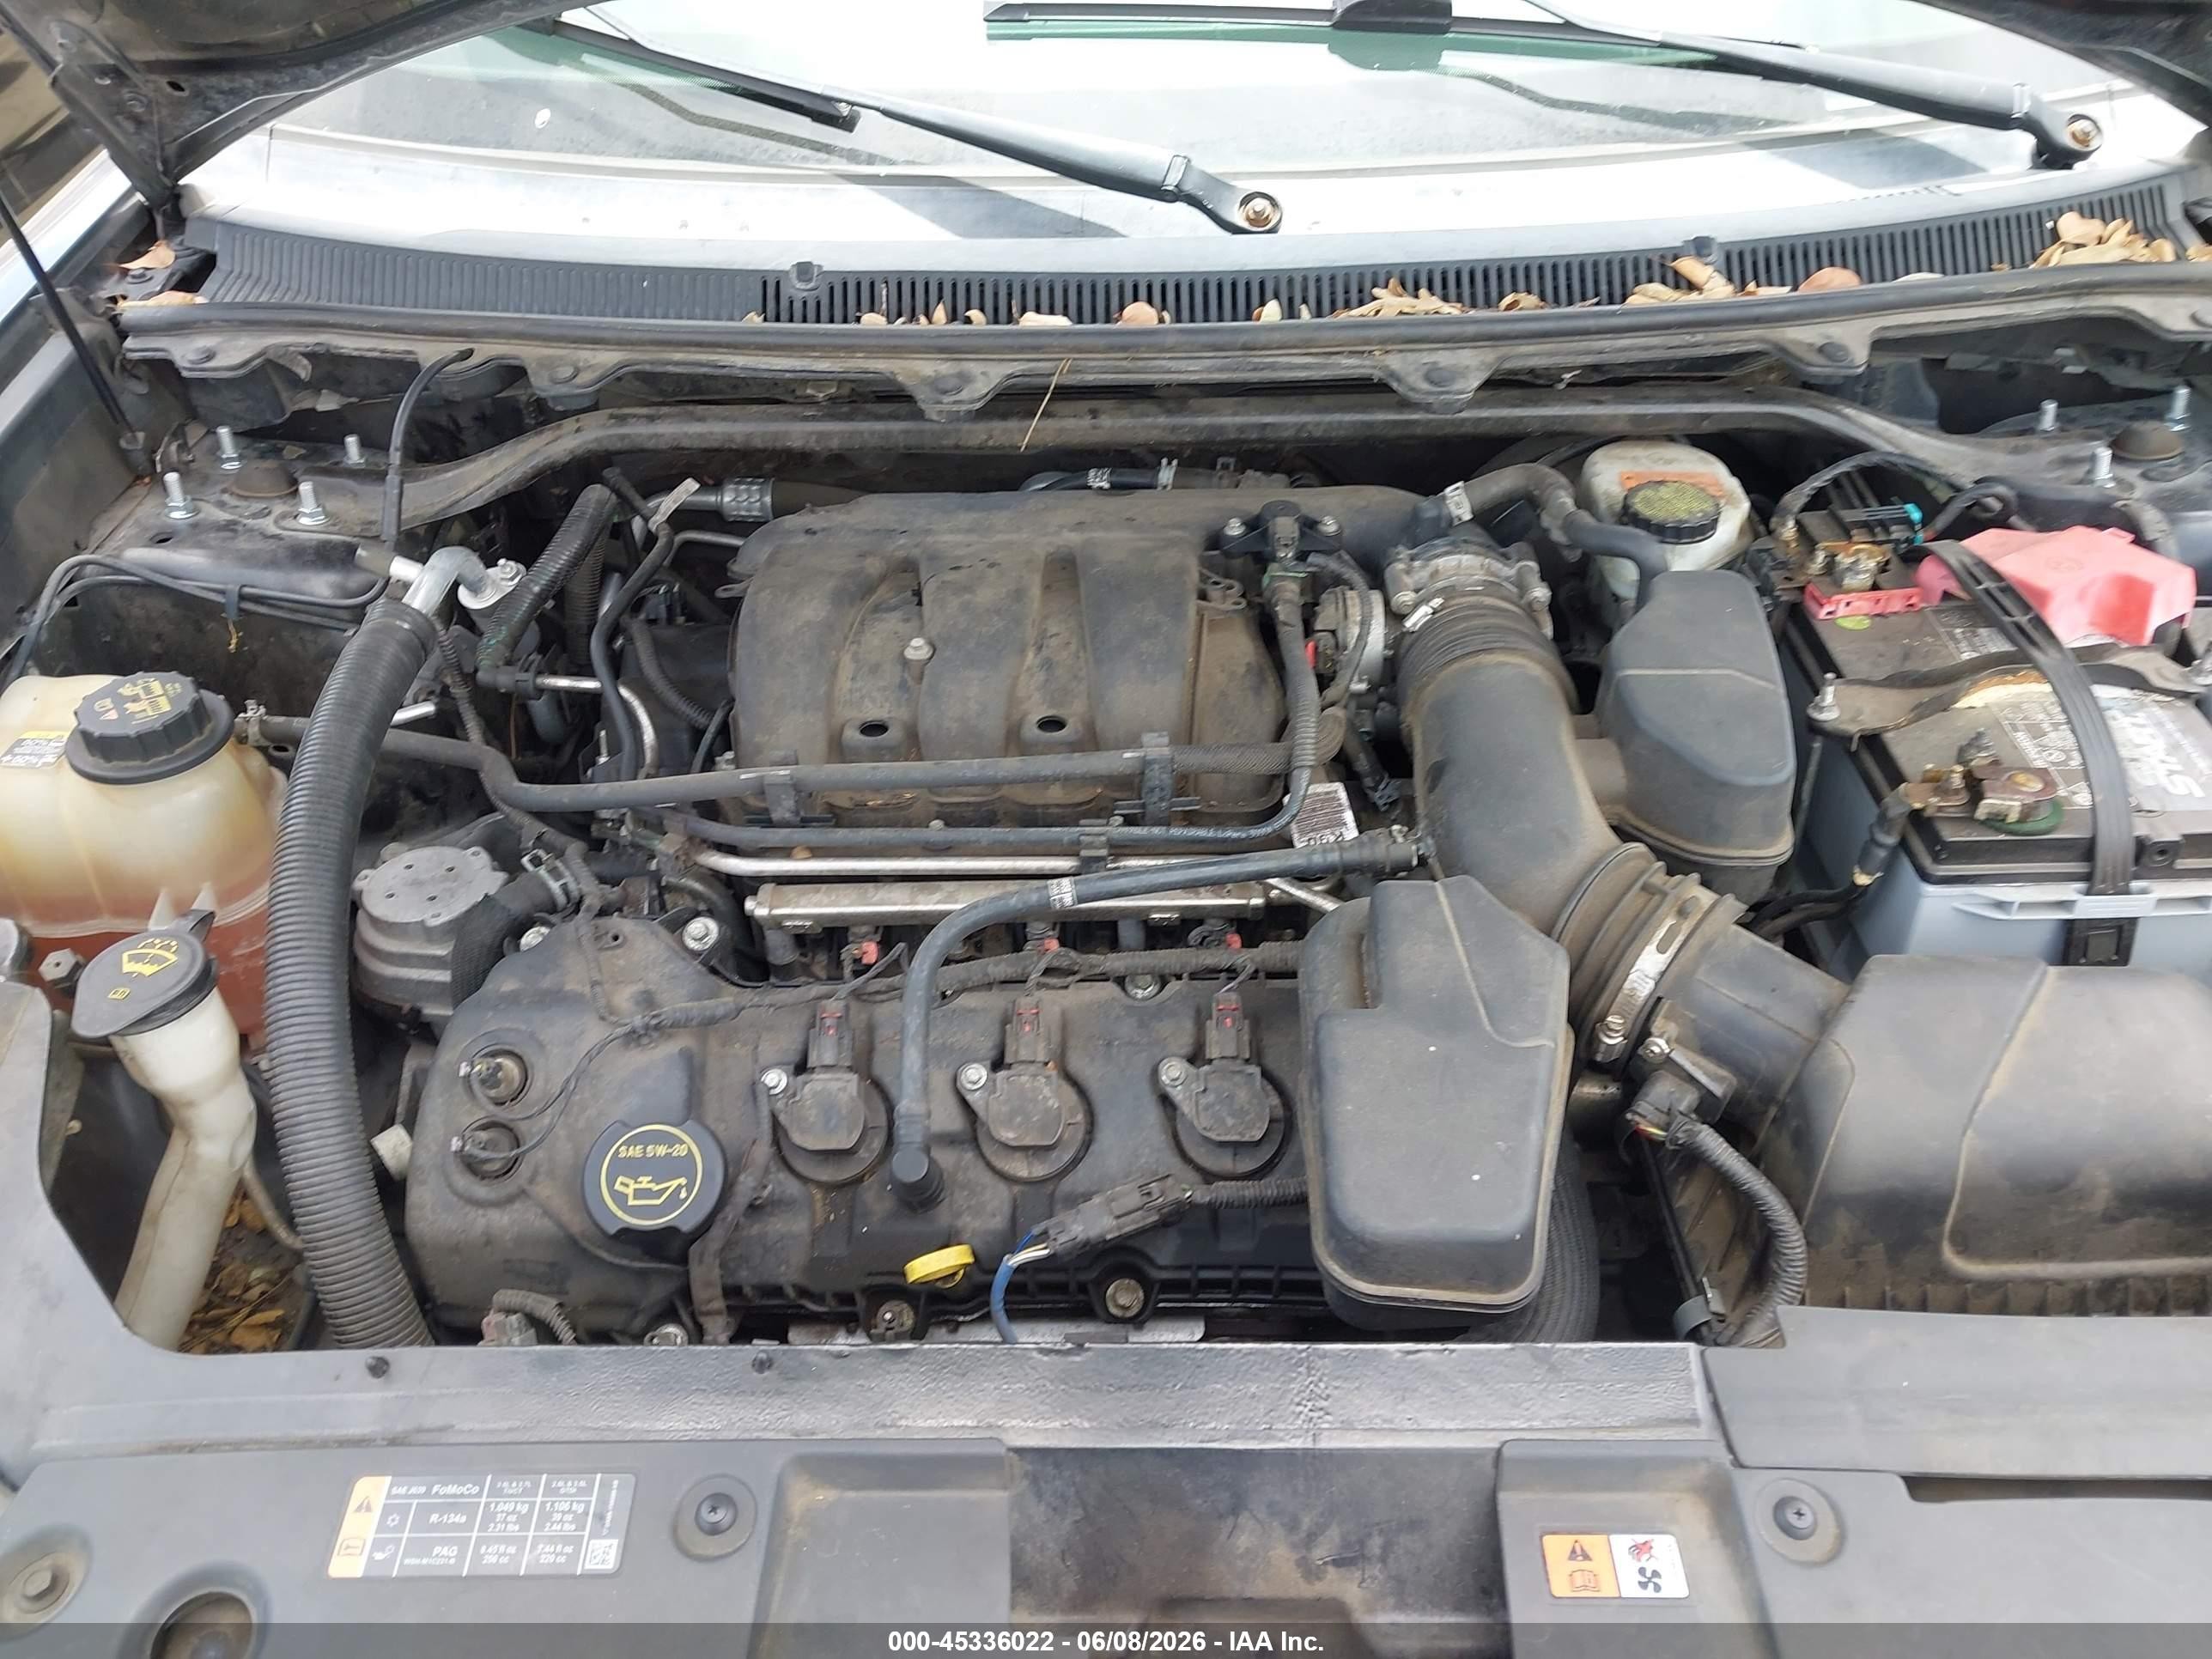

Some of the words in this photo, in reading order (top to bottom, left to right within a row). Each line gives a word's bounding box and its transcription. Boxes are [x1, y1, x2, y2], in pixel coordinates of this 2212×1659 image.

[617, 1145, 644, 1158] SAE
[646, 1144, 689, 1158] 5W-20
[431, 1484, 480, 1495] FoMoCo
[515, 1502, 529, 1515] kg
[571, 1501, 585, 1514] kg
[429, 1513, 467, 1523] R-134a
[562, 1513, 574, 1522] oz
[506, 1522, 520, 1531] lbs
[562, 1522, 576, 1531] lbs
[432, 1546, 459, 1557] PAG
